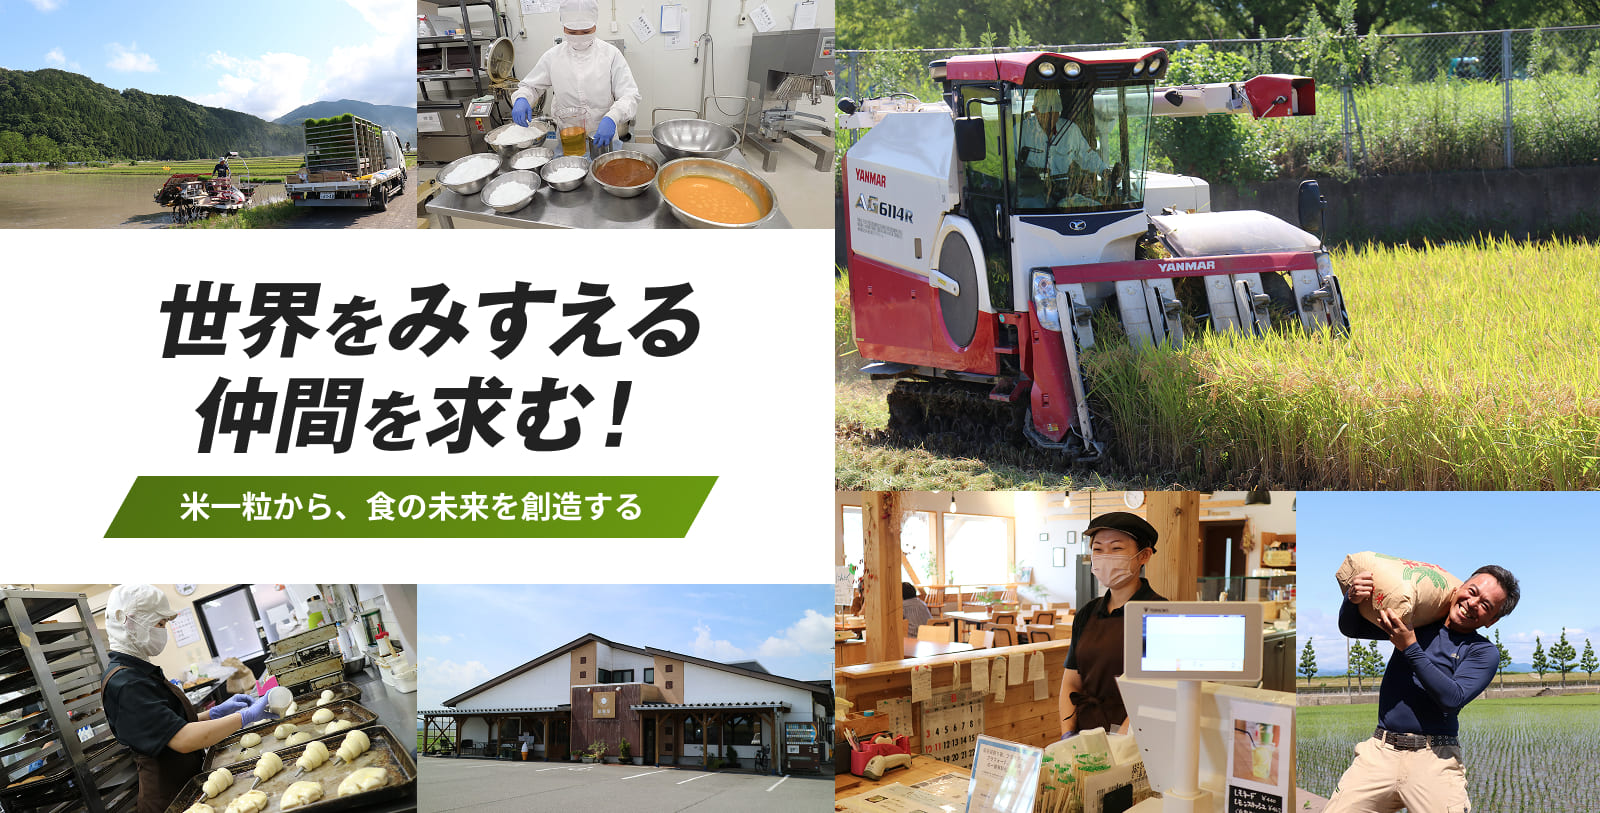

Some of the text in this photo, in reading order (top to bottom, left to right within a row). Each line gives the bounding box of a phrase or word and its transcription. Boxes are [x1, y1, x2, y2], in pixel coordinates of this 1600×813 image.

[856, 168, 886, 188] YANMAR
[1158, 260, 1215, 272] YANMAR
[944, 726, 948, 734] 5
[935, 743, 941, 751] 11
[952, 753, 959, 761] 20
[961, 751, 966, 759] 21
